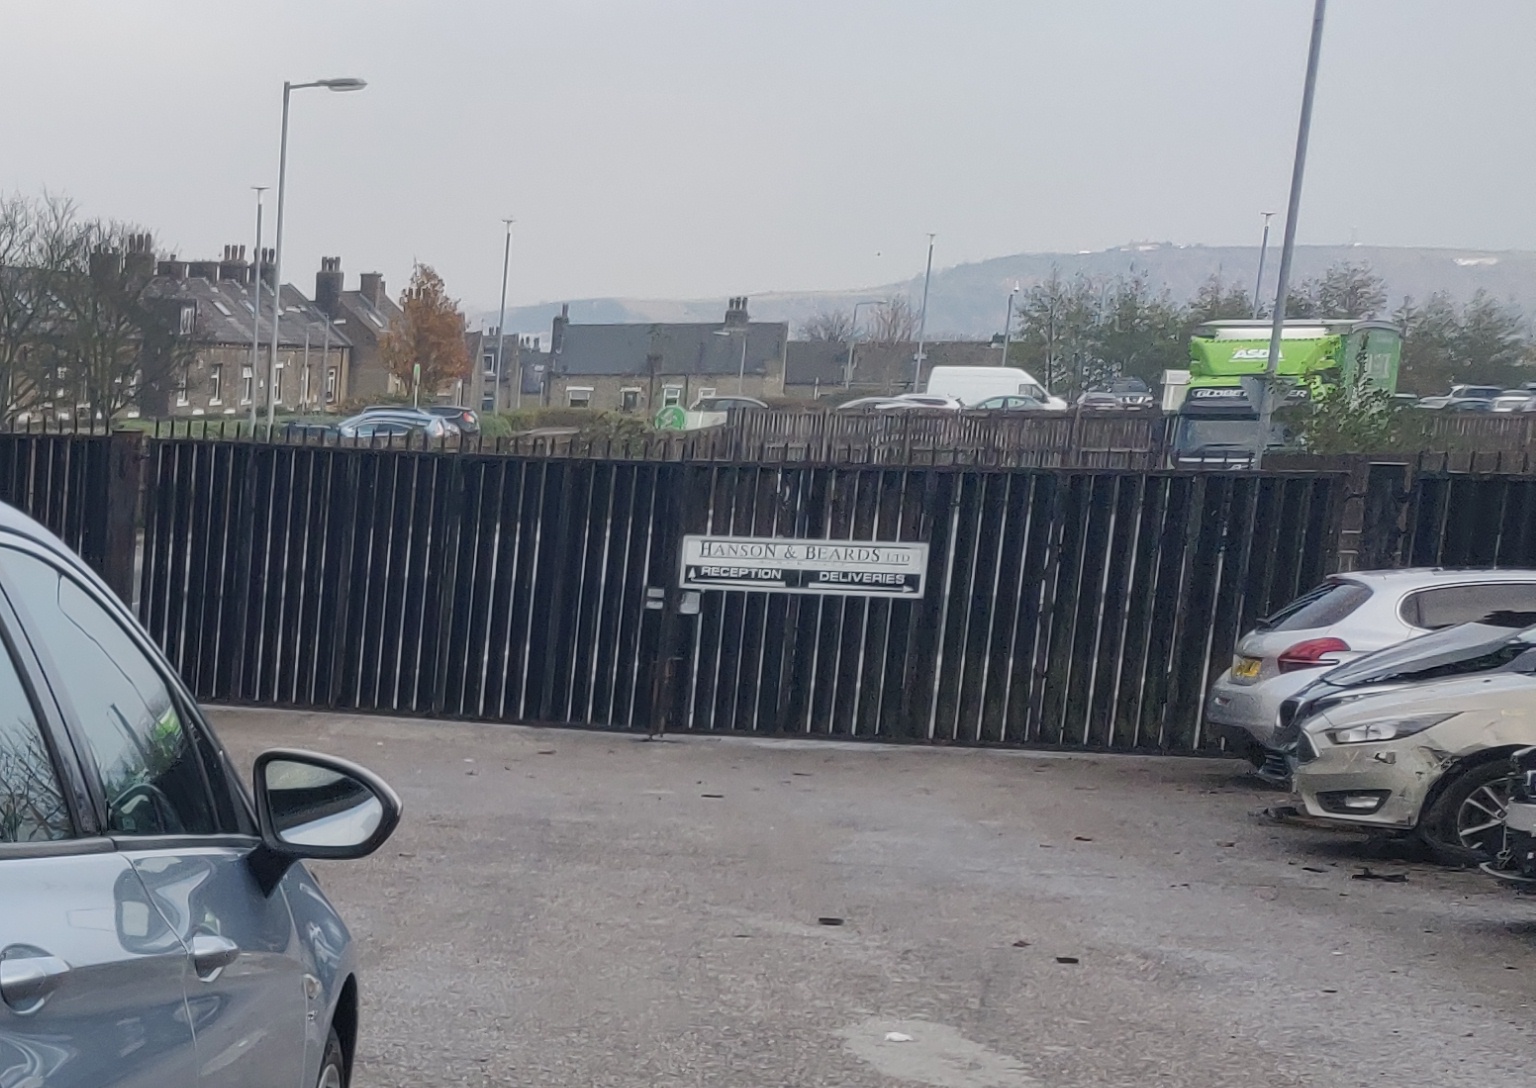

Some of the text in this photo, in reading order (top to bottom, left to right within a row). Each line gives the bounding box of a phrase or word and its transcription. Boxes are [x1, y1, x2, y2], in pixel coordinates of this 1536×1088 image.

[699, 540, 911, 564] HANSON & BEARDS LTD
[700, 566, 782, 580] RECEPTION
[819, 571, 906, 585] DELIVERIES
